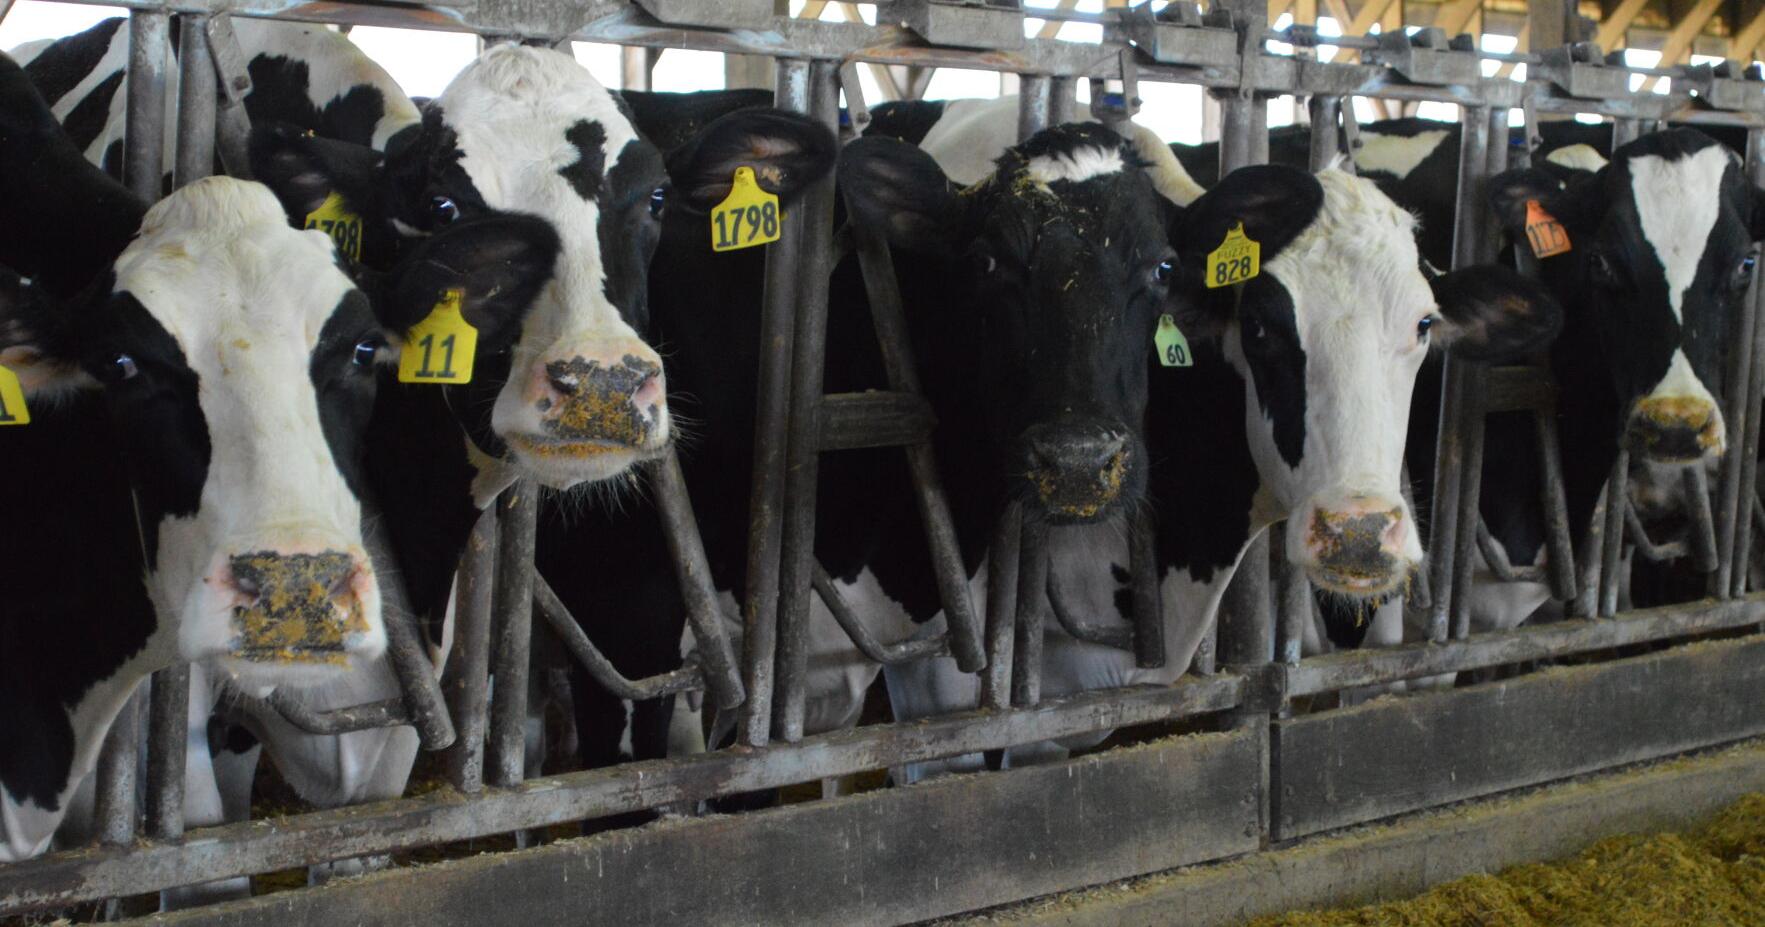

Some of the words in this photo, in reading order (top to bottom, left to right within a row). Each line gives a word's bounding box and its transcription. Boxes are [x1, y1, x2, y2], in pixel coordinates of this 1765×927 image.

[307, 219, 359, 259] 798
[715, 201, 777, 248] 1798
[1216, 256, 1251, 284] 828
[415, 334, 456, 378] 11
[1167, 344, 1185, 364] 60
